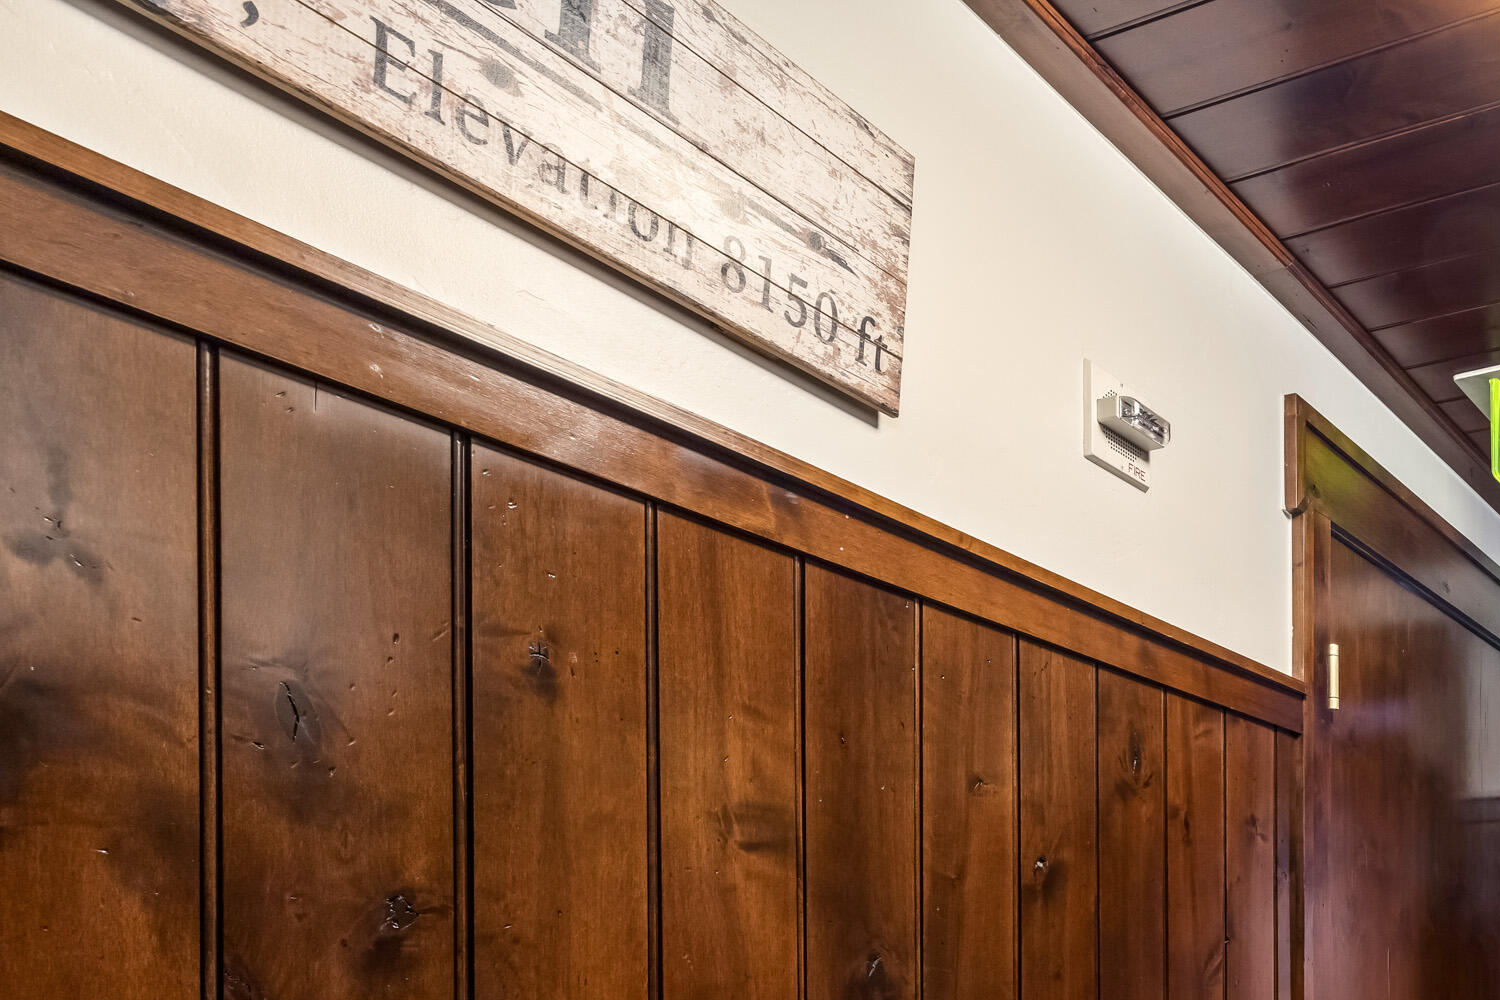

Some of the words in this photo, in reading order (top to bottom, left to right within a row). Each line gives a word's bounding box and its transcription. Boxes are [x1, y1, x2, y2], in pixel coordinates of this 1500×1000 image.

[369, 15, 695, 271] Elevation
[720, 235, 838, 345] 8150
[855, 316, 888, 375] ft
[1128, 462, 1146, 482] FIRE
